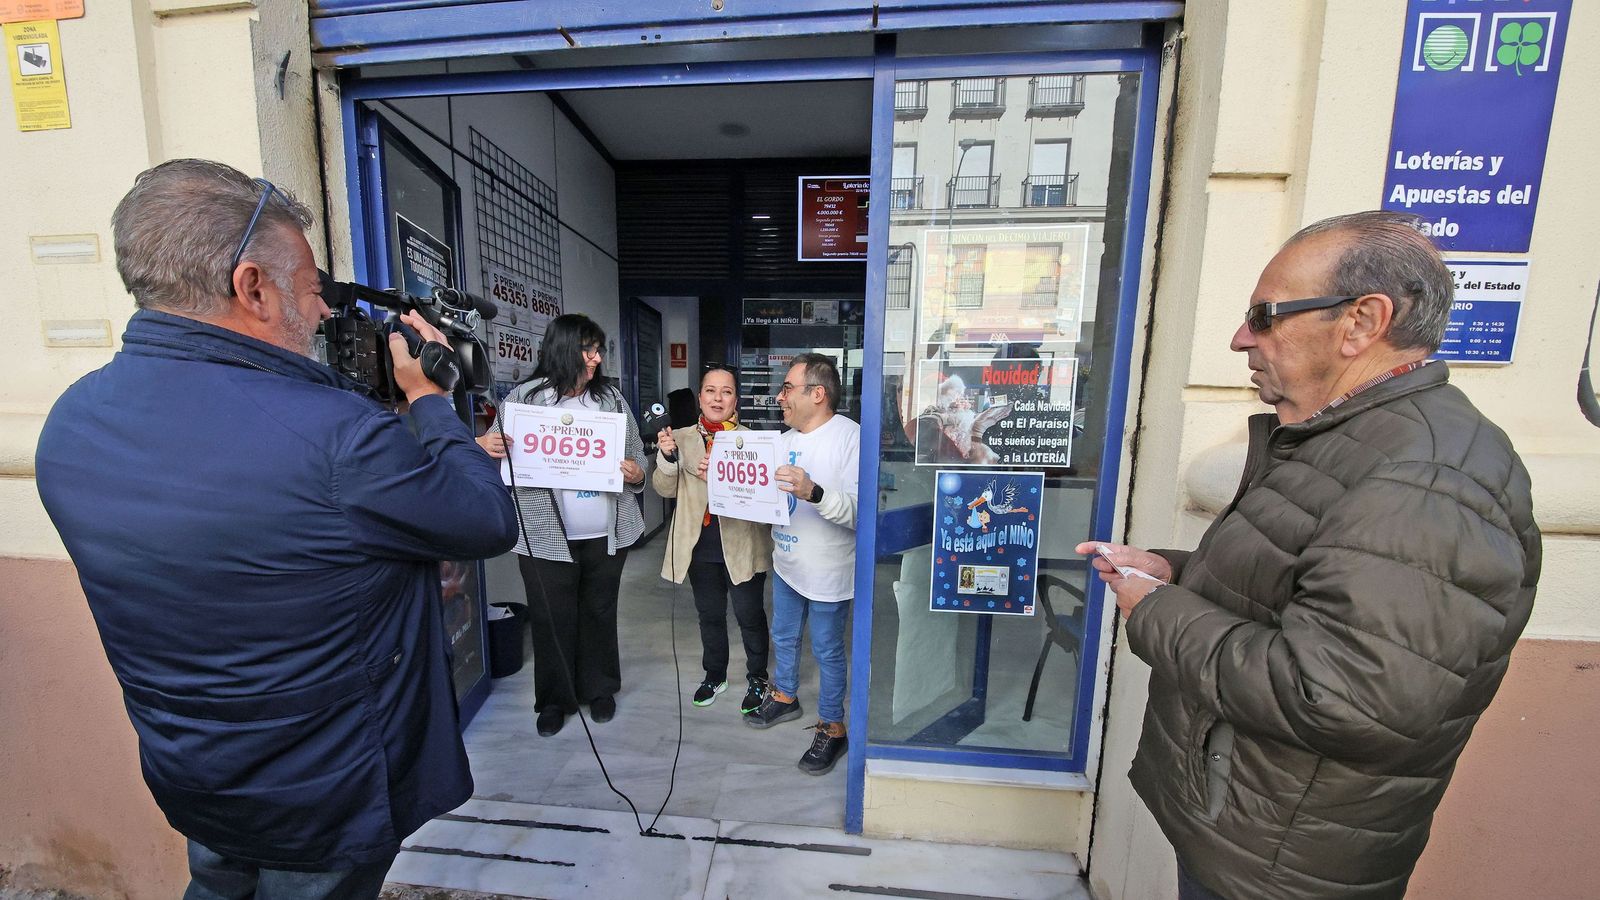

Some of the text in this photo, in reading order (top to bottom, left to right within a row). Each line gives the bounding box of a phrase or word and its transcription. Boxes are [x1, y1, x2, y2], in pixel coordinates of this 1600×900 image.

[1394, 150, 1504, 176] Loterías y
[1389, 184, 1532, 208] Apuestas del
[1033, 231, 1070, 242] VIAJERO
[1459, 270, 1466, 279] y
[500, 276, 525, 292] PREMIO
[1464, 281, 1480, 290] del
[1484, 282, 1521, 290] Estado
[493, 283, 528, 308] 45353
[538, 292, 558, 305] PREMIO
[532, 298, 560, 318] 88979
[506, 334, 530, 347] PREMIO
[499, 341, 532, 362] 57421
[982, 362, 1039, 384] Navidad
[1014, 400, 1070, 412] Cada Navidad
[1001, 418, 1069, 429] en El Paraíso
[551, 425, 593, 437] PREMIO
[523, 433, 606, 459] 90693
[989, 436, 1068, 448] tus sueños juegan
[731, 451, 758, 460] PREMIO
[1012, 453, 1021, 463] la
[1023, 451, 1066, 463] LOTERÍA
[717, 461, 769, 486] 90693
[941, 522, 1034, 553] Ya está aquí el NIÑO
